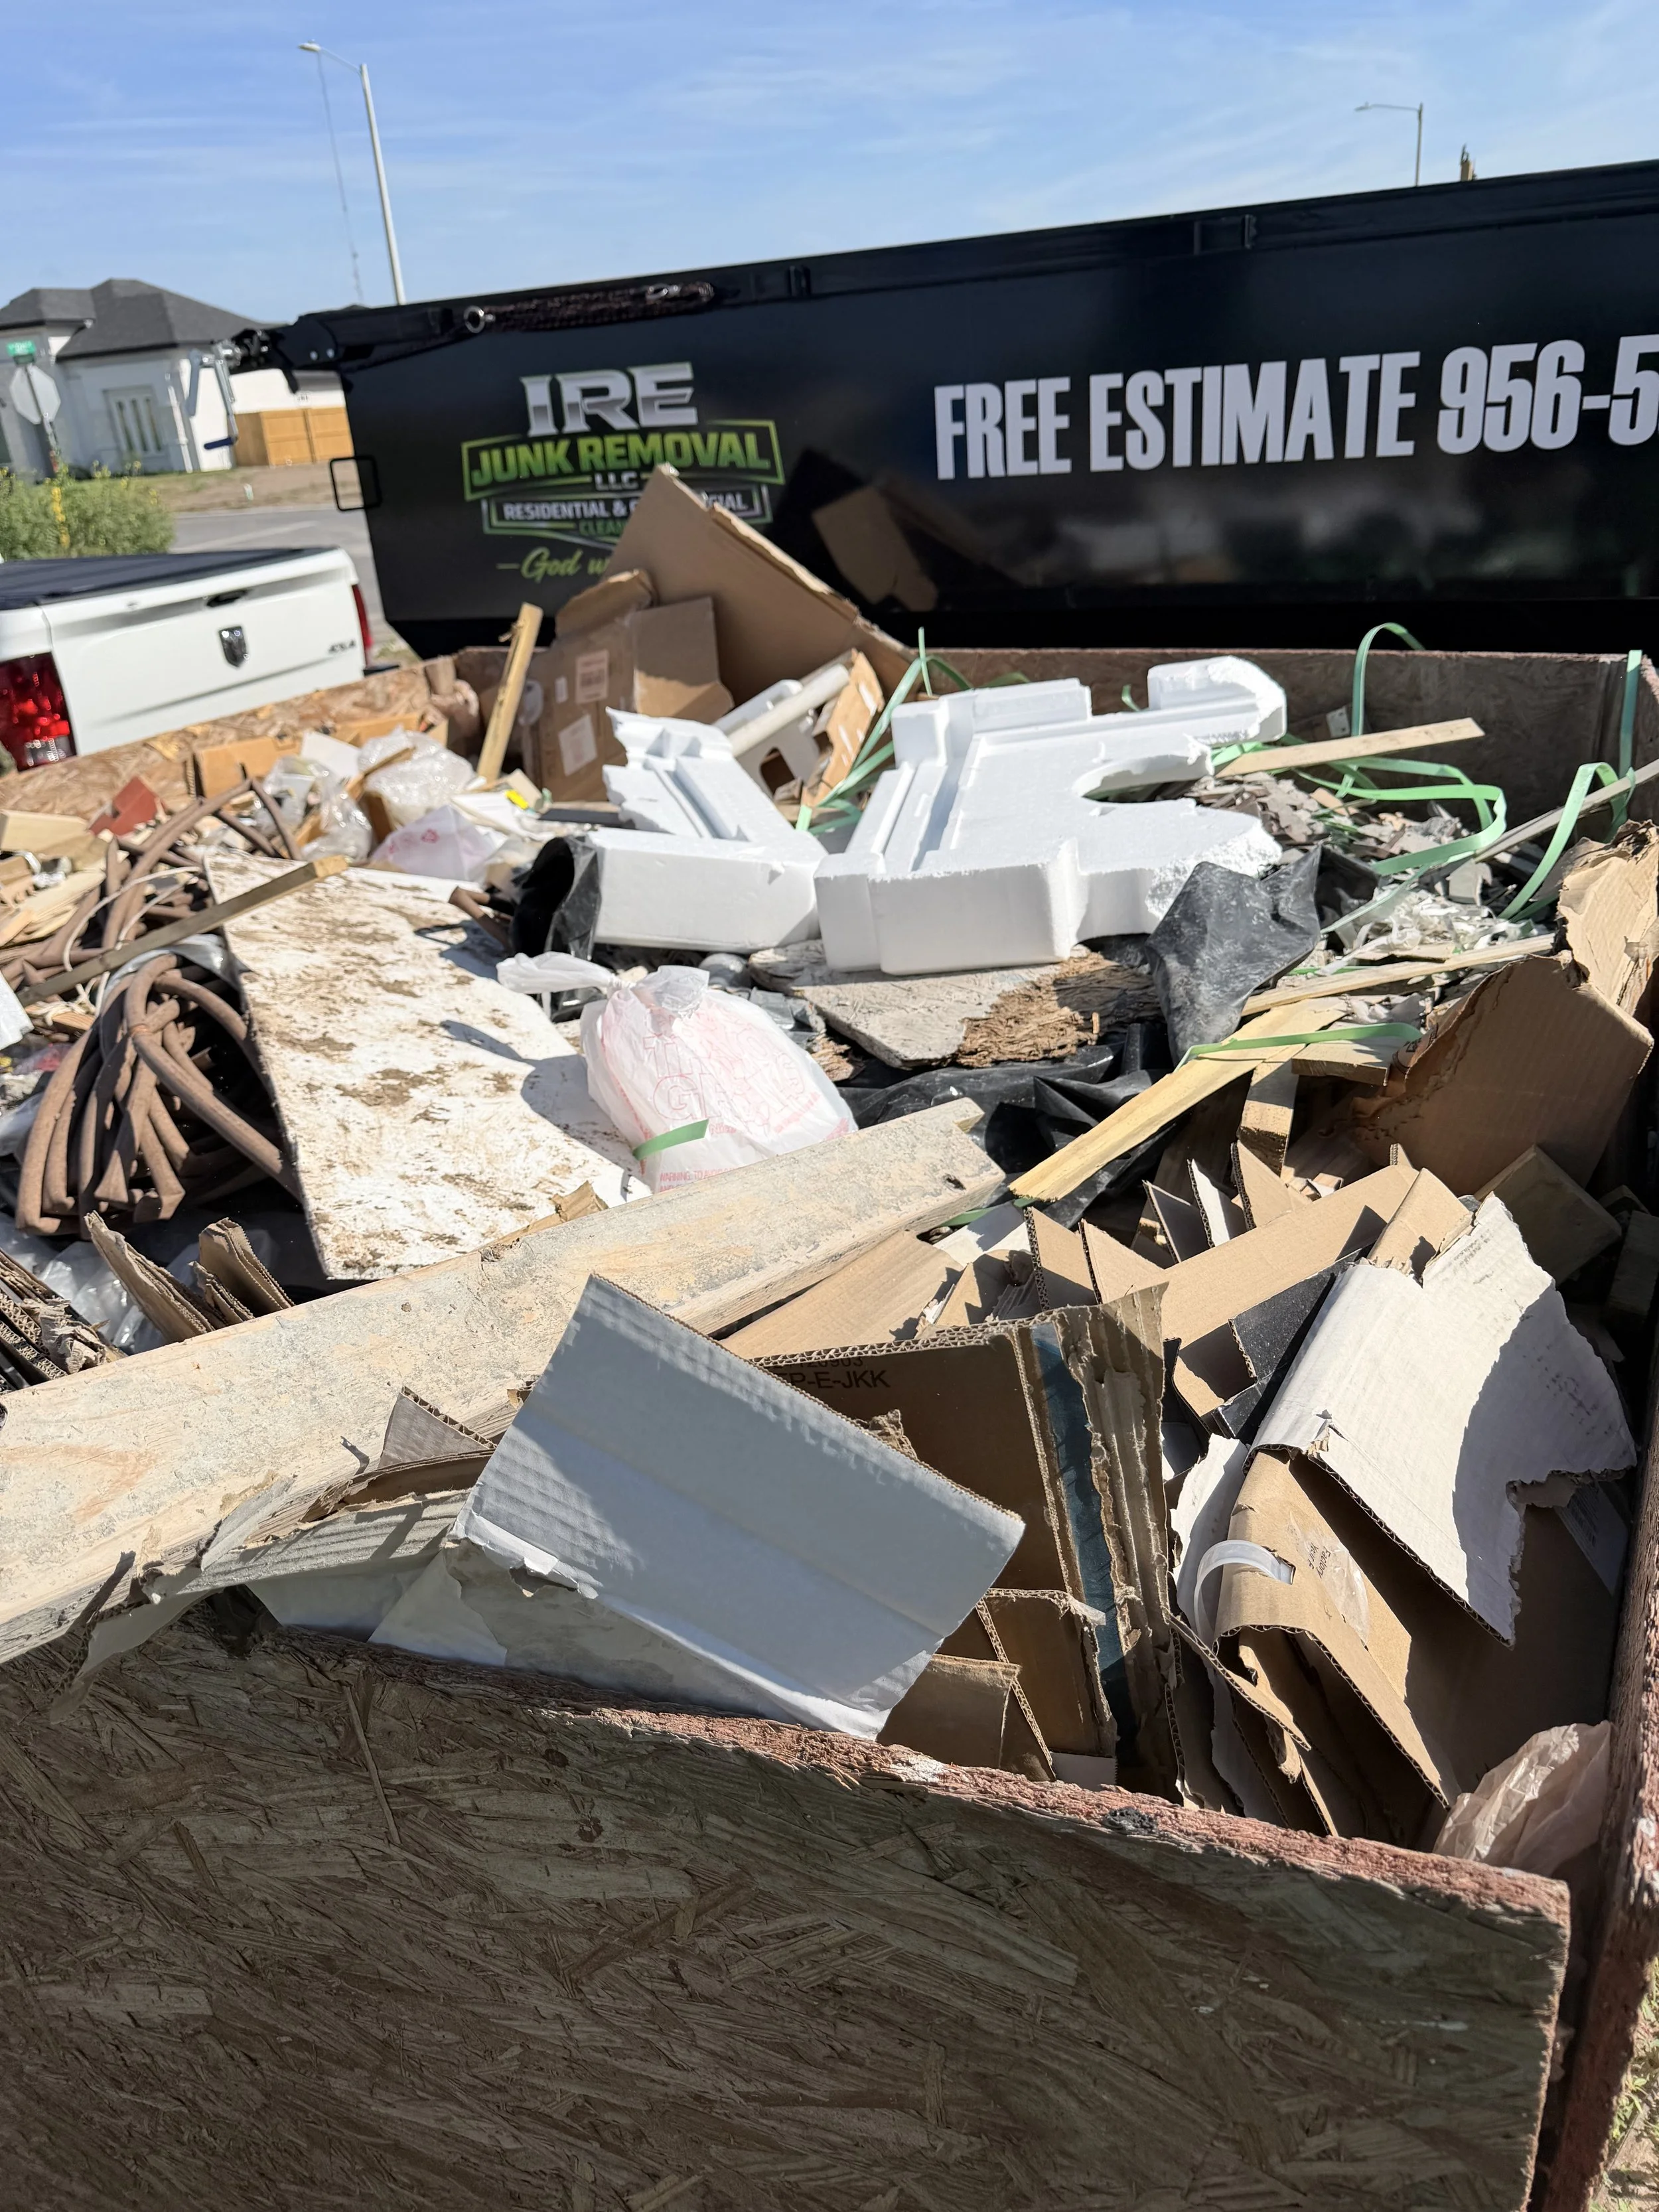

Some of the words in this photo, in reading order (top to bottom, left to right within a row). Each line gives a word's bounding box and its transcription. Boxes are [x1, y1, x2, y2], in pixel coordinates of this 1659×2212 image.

[520, 362, 699, 437] IRE
[934, 376, 1071, 480] FREE
[1089, 350, 1421, 473] ESTIMATE
[470, 439, 575, 486] JUNK
[577, 431, 771, 472] REMOVAL
[594, 471, 640, 490] LLC
[503, 499, 610, 521] RESIDENTIAL
[612, 498, 627, 518] &
[520, 546, 584, 583] God
[1316, 1546, 1331, 1579] Factory
